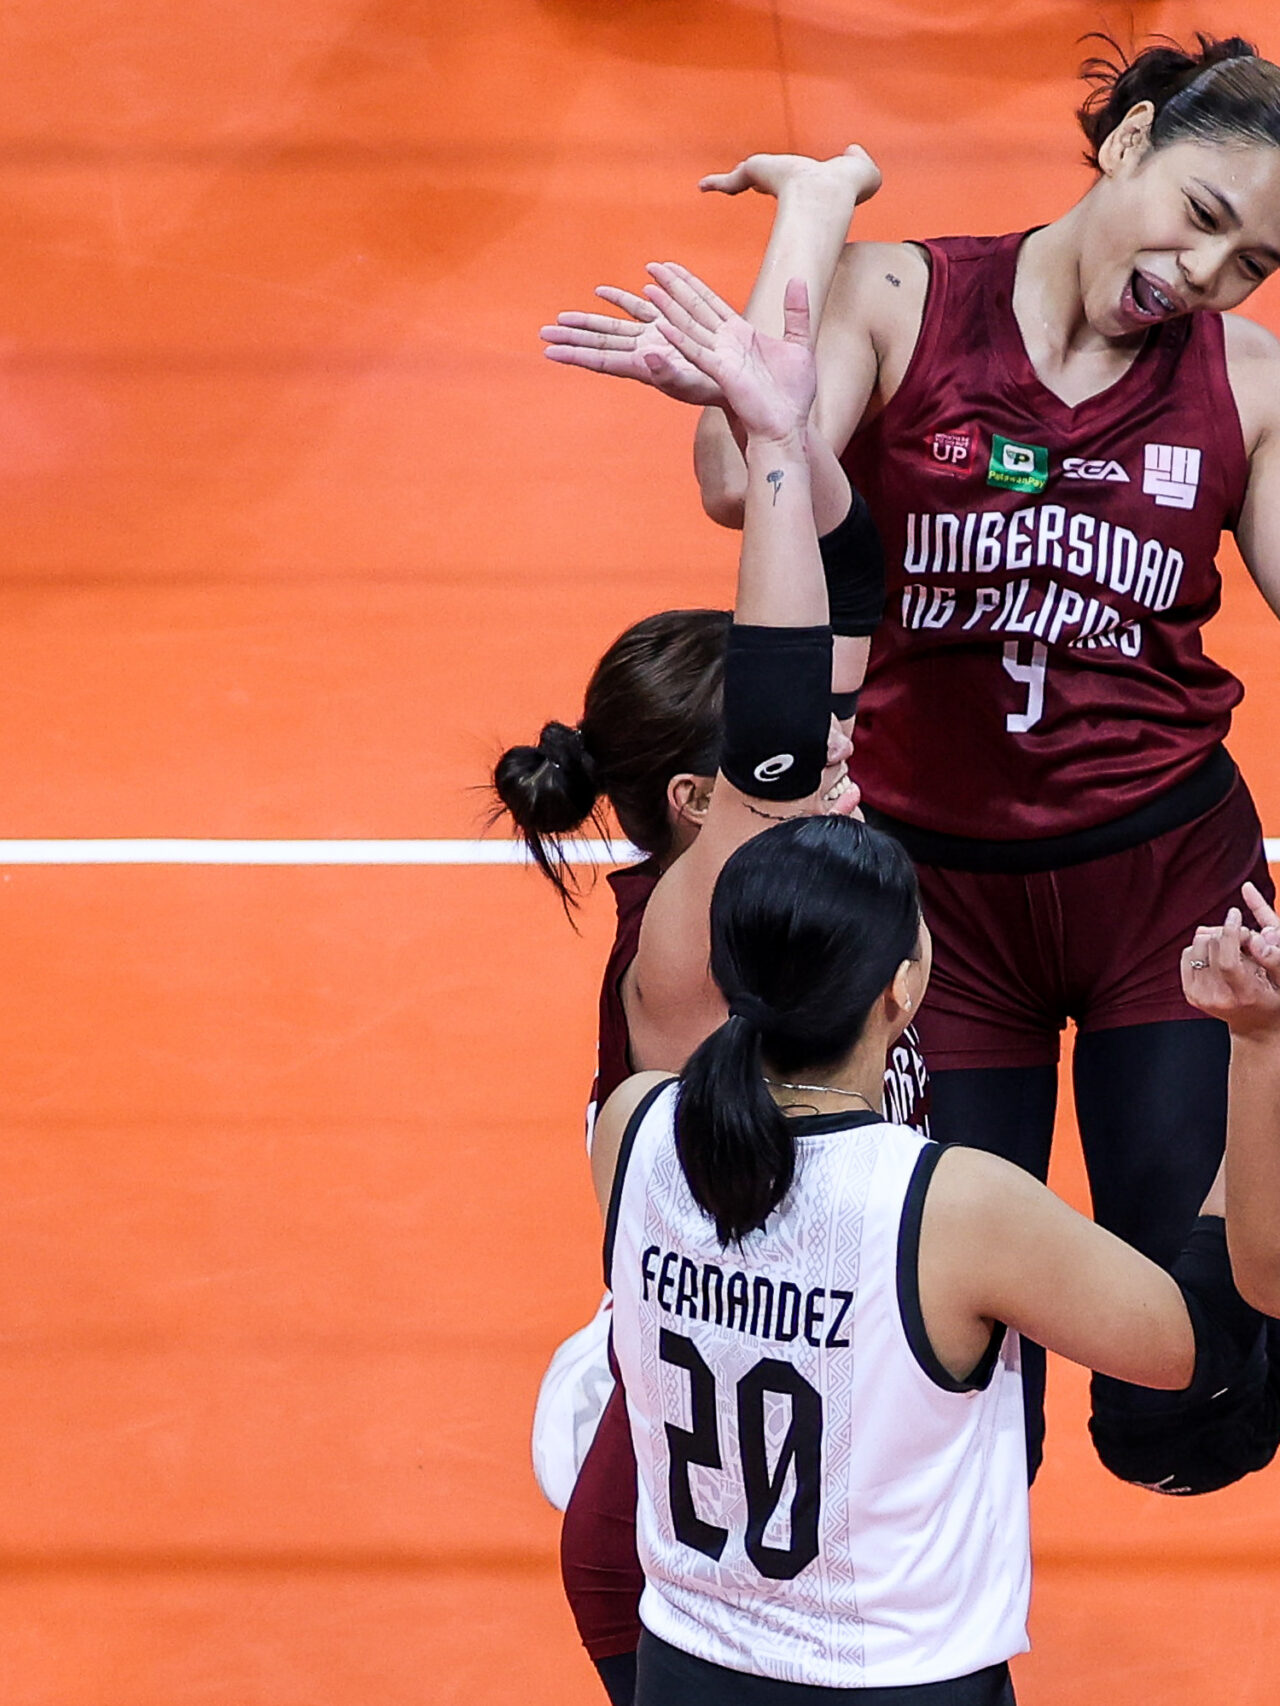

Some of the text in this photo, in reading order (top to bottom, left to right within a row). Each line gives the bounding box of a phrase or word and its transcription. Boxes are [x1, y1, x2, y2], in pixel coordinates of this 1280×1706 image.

[933, 442, 967, 463] UP
[902, 584, 955, 629] NG
[904, 504, 1184, 612] UNIBERSIDAD
[1002, 640, 1047, 732] 9
[642, 1245, 854, 1348] FERNANDEZ
[659, 1327, 823, 1580] 20
